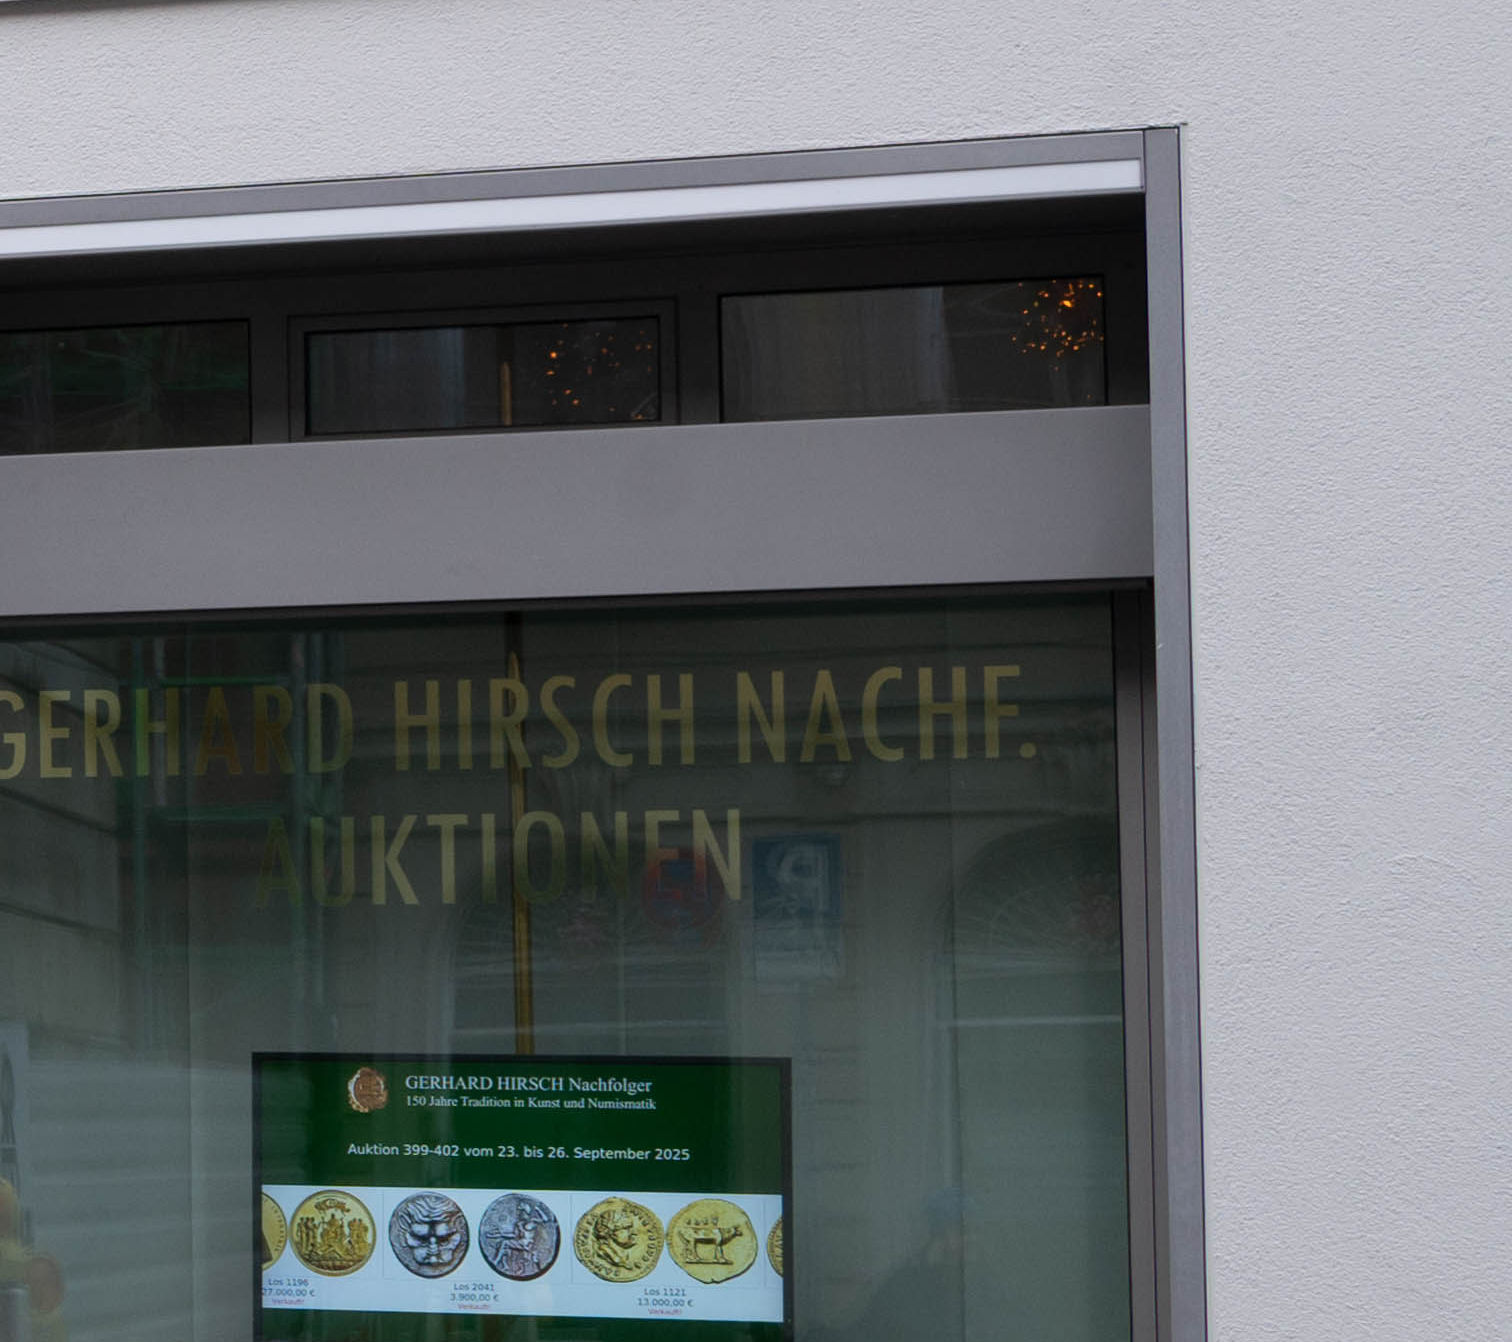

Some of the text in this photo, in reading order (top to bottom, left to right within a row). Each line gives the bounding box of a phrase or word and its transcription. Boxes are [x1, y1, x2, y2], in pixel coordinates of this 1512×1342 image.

[393, 672, 696, 774] HIRSCH
[737, 665, 1039, 767] NACHF.
[256, 809, 745, 907] AUKTIONEN
[405, 1075, 653, 1096] GERHARD HIRSCH Nachfolger
[406, 1096, 657, 1110] 150 Jahre Tradition in Kunst und Numismatik
[347, 1143, 691, 1163] Auktion 399-402 vom 23. bis 26. September 2025
[453, 1282, 495, 1292] Los 2041
[644, 1287, 687, 1297] Los 1121
